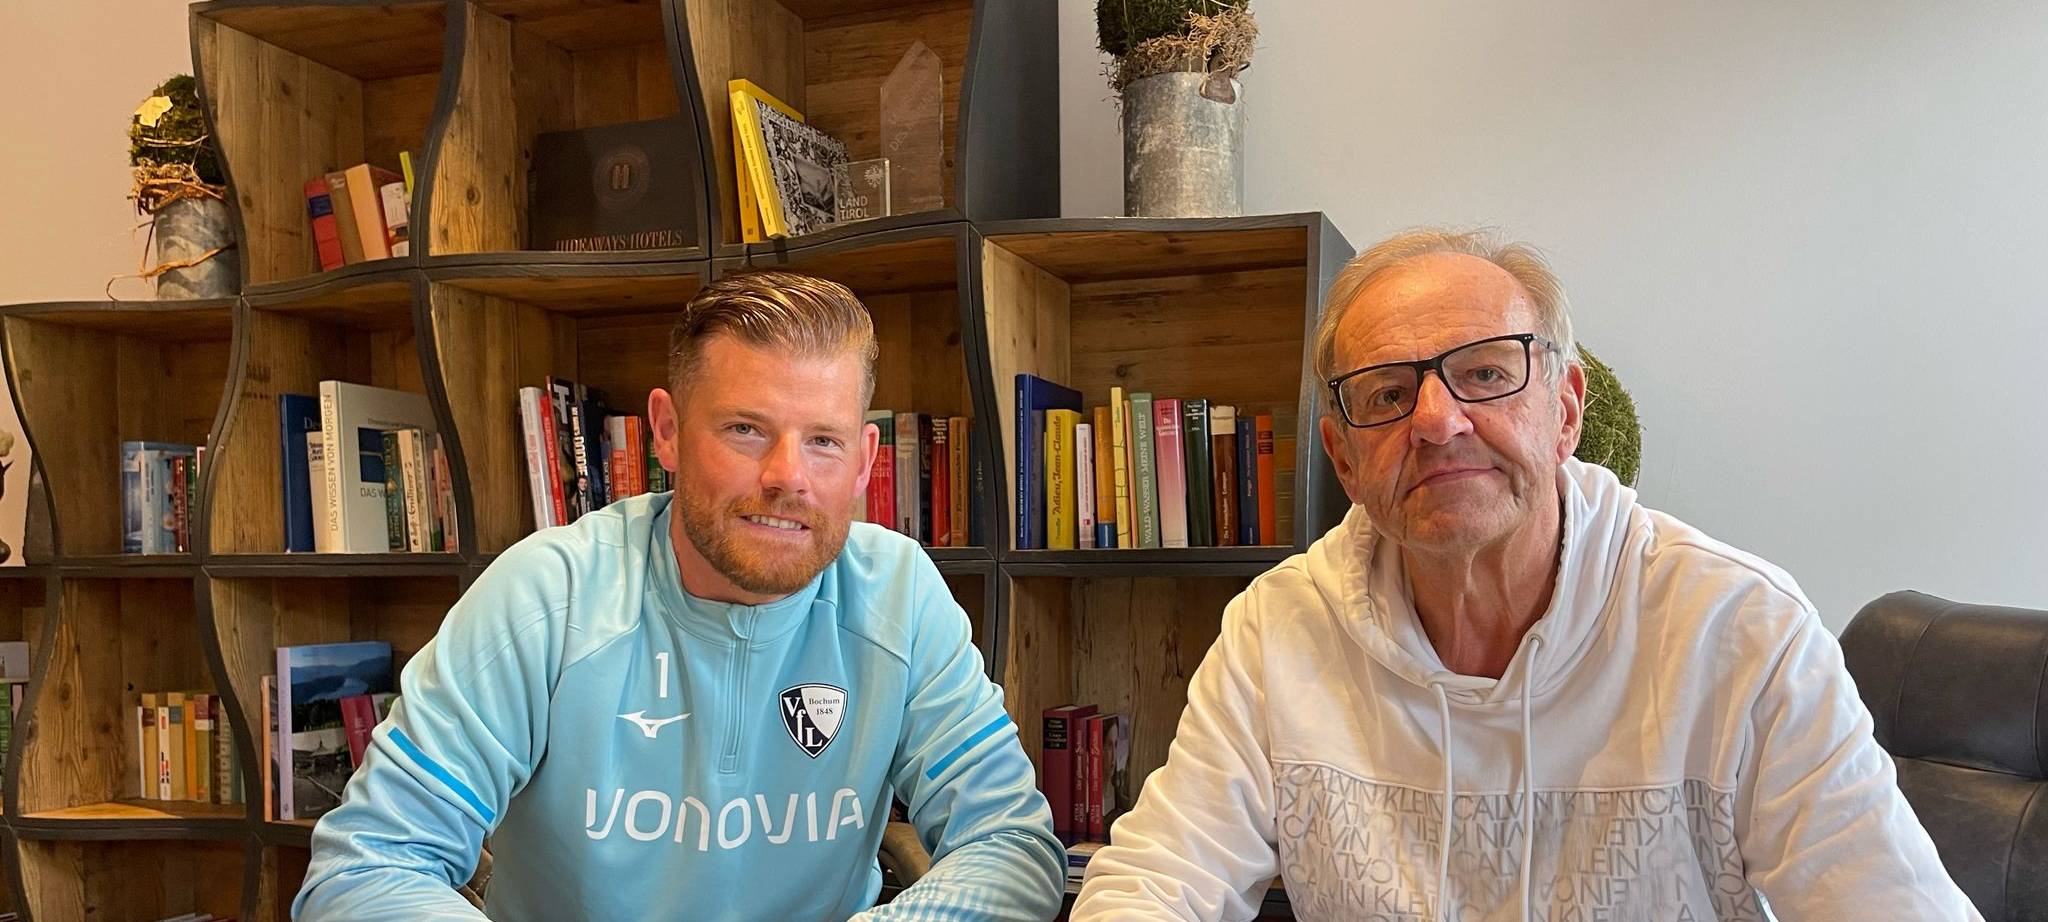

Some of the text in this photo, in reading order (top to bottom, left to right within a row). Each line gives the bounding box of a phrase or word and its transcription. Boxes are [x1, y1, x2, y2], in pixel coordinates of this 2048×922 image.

[839, 195, 868, 209] LAND
[839, 207, 870, 220] TIROL
[556, 229, 683, 252] HIDEAWAYS HOTELS
[323, 393, 335, 441] MORGEN
[1138, 411, 1147, 439] WELT
[325, 443, 335, 464] VON
[326, 467, 337, 508] WISSEN
[360, 487, 377, 498] DAS
[655, 652, 669, 698] 1
[808, 697, 841, 706] Bochum
[815, 707, 834, 716] 1848
[586, 788, 864, 851] VONOVIA
[1283, 815, 1370, 856] CALVIN
